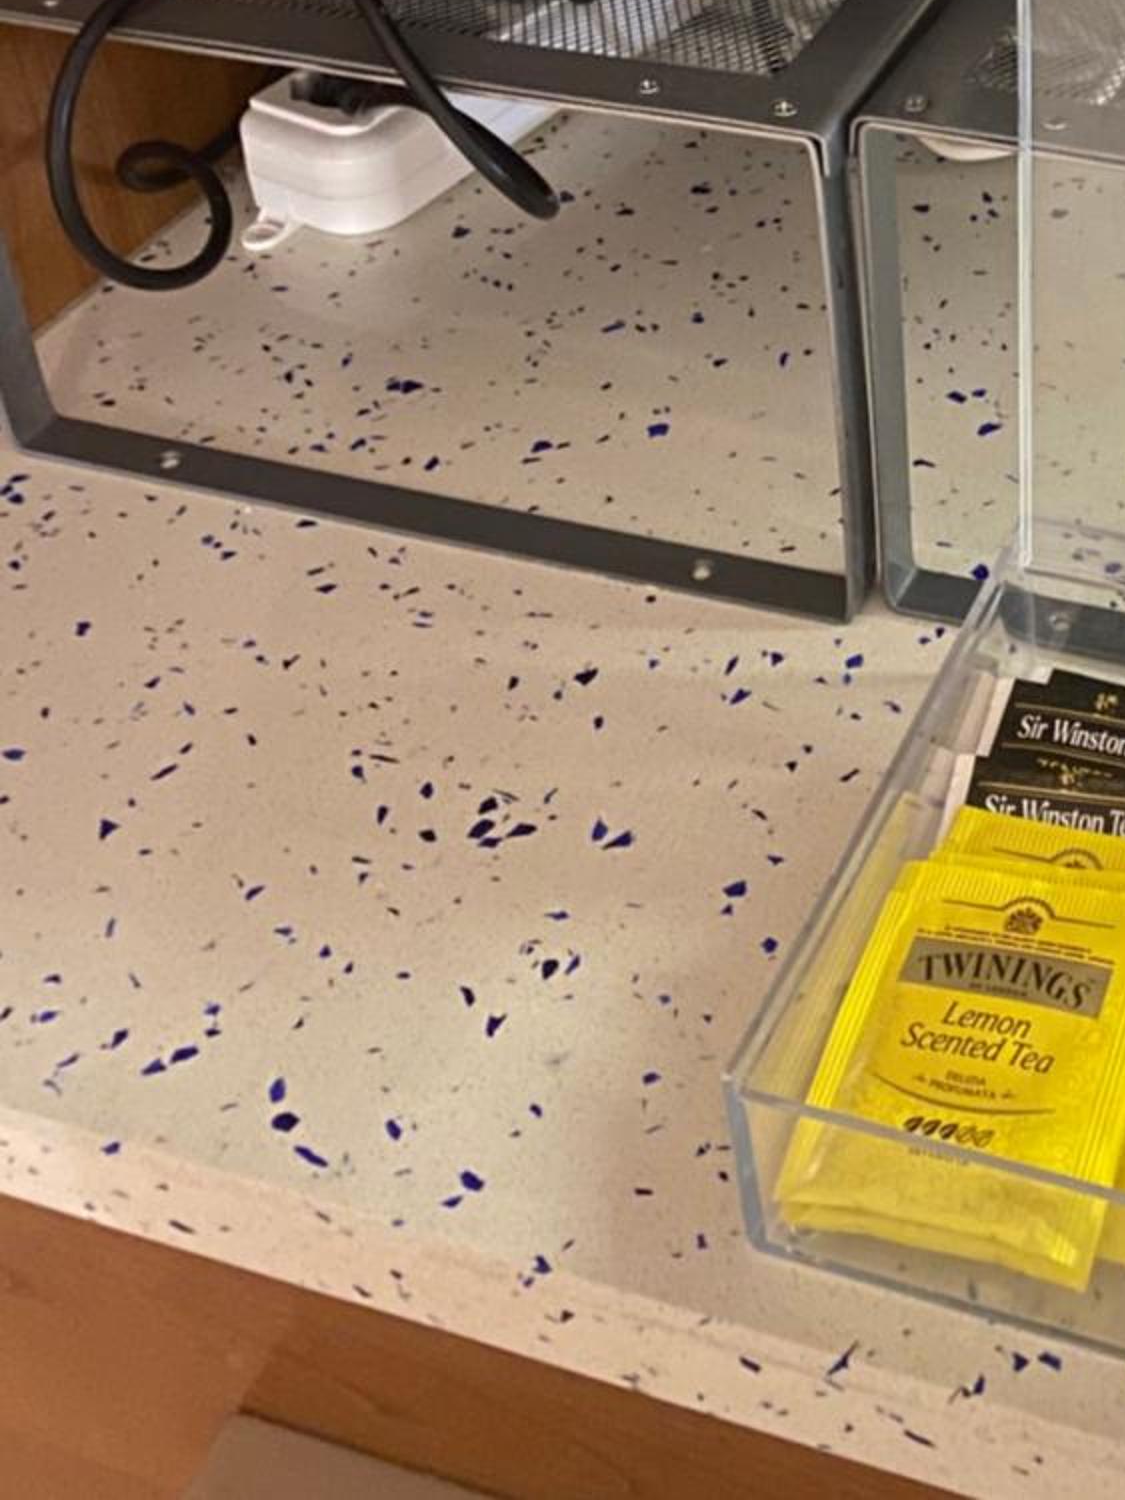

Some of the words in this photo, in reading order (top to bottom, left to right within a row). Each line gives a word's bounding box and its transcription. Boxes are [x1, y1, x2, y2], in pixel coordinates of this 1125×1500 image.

[1016, 712, 1051, 741] Sir
[984, 793, 1016, 816] Sir
[1021, 798, 1105, 835] Winston
[917, 951, 1093, 1010] TWININGS
[941, 999, 1033, 1039] Lemon
[900, 1021, 1011, 1062] Scented
[1008, 1040, 1056, 1075] Tea
